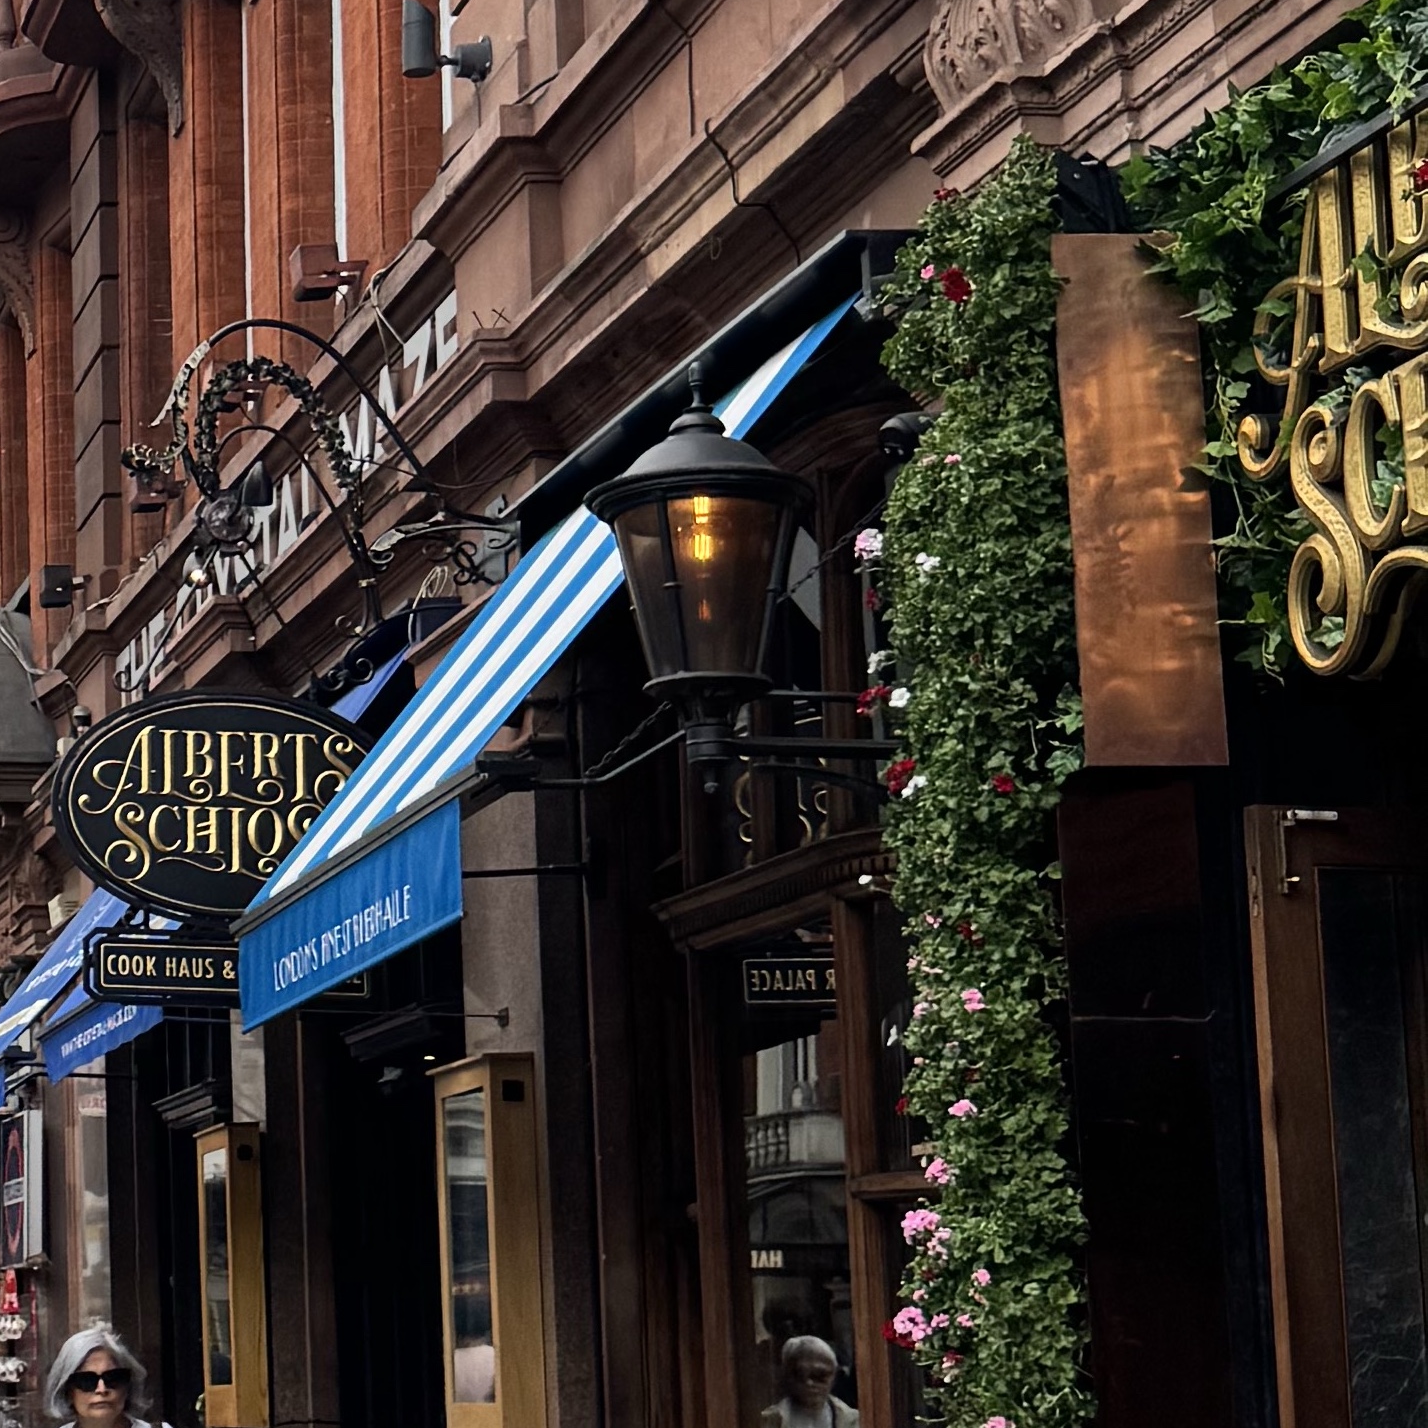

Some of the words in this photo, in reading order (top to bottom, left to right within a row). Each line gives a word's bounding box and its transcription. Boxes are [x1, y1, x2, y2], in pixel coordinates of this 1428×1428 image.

[106, 954, 157, 978] COOK
[165, 956, 215, 980] HAUS
[222, 959, 237, 980] &
